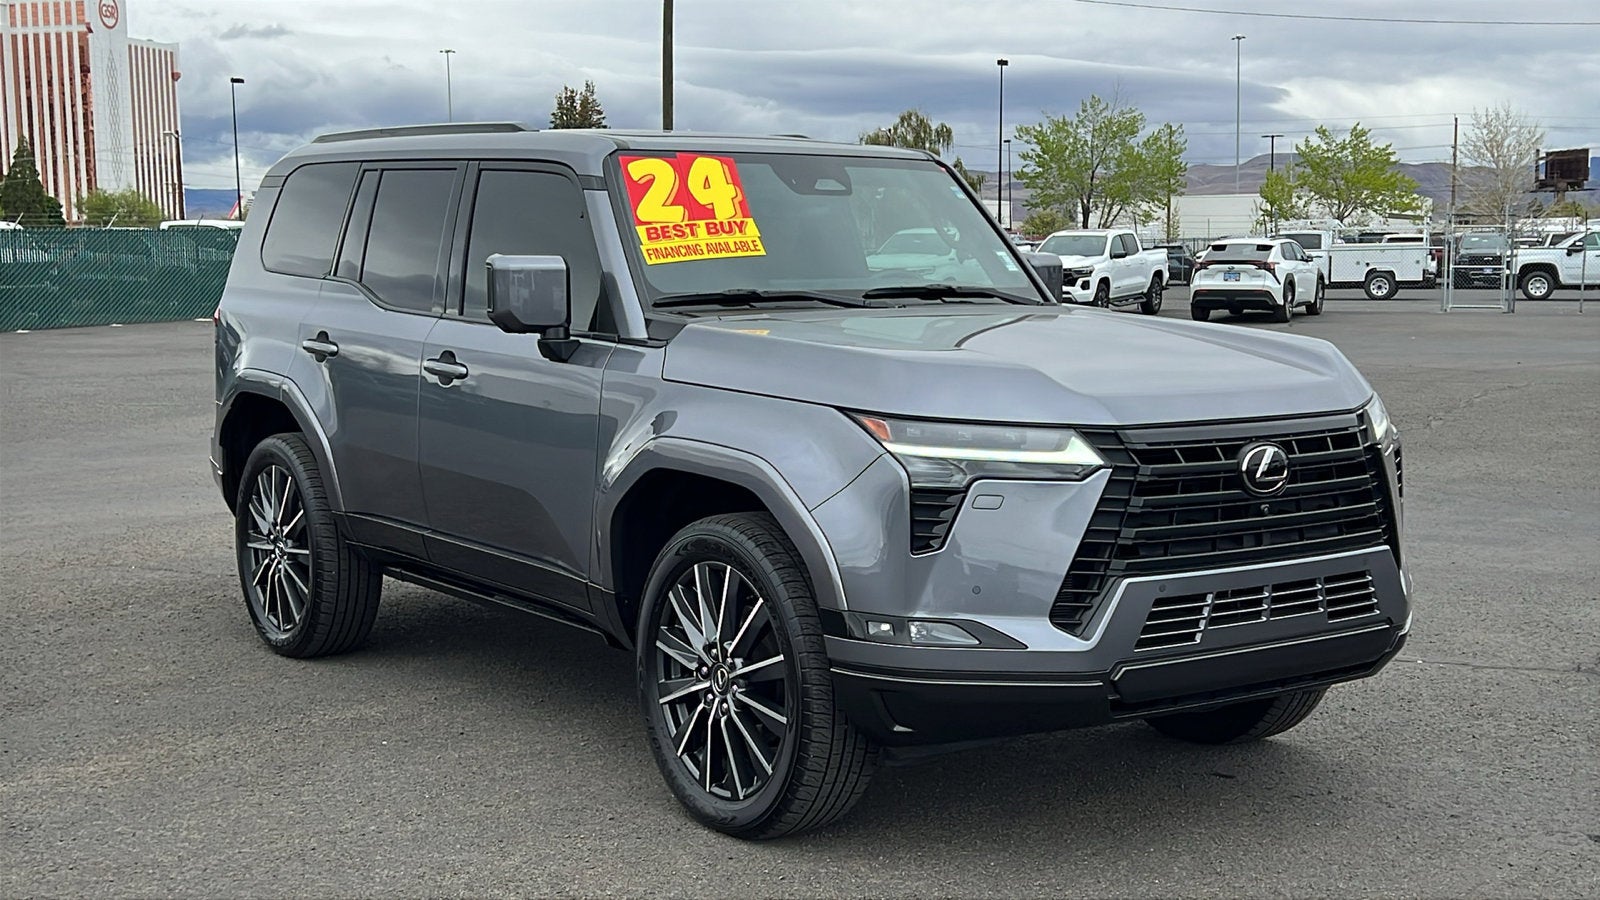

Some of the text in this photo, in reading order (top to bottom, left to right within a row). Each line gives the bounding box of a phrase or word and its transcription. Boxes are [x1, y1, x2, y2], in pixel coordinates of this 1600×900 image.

[627, 157, 742, 222] 24
[645, 219, 748, 241] BEST BUY
[646, 239, 761, 261] FINANCING AVAILABLE
